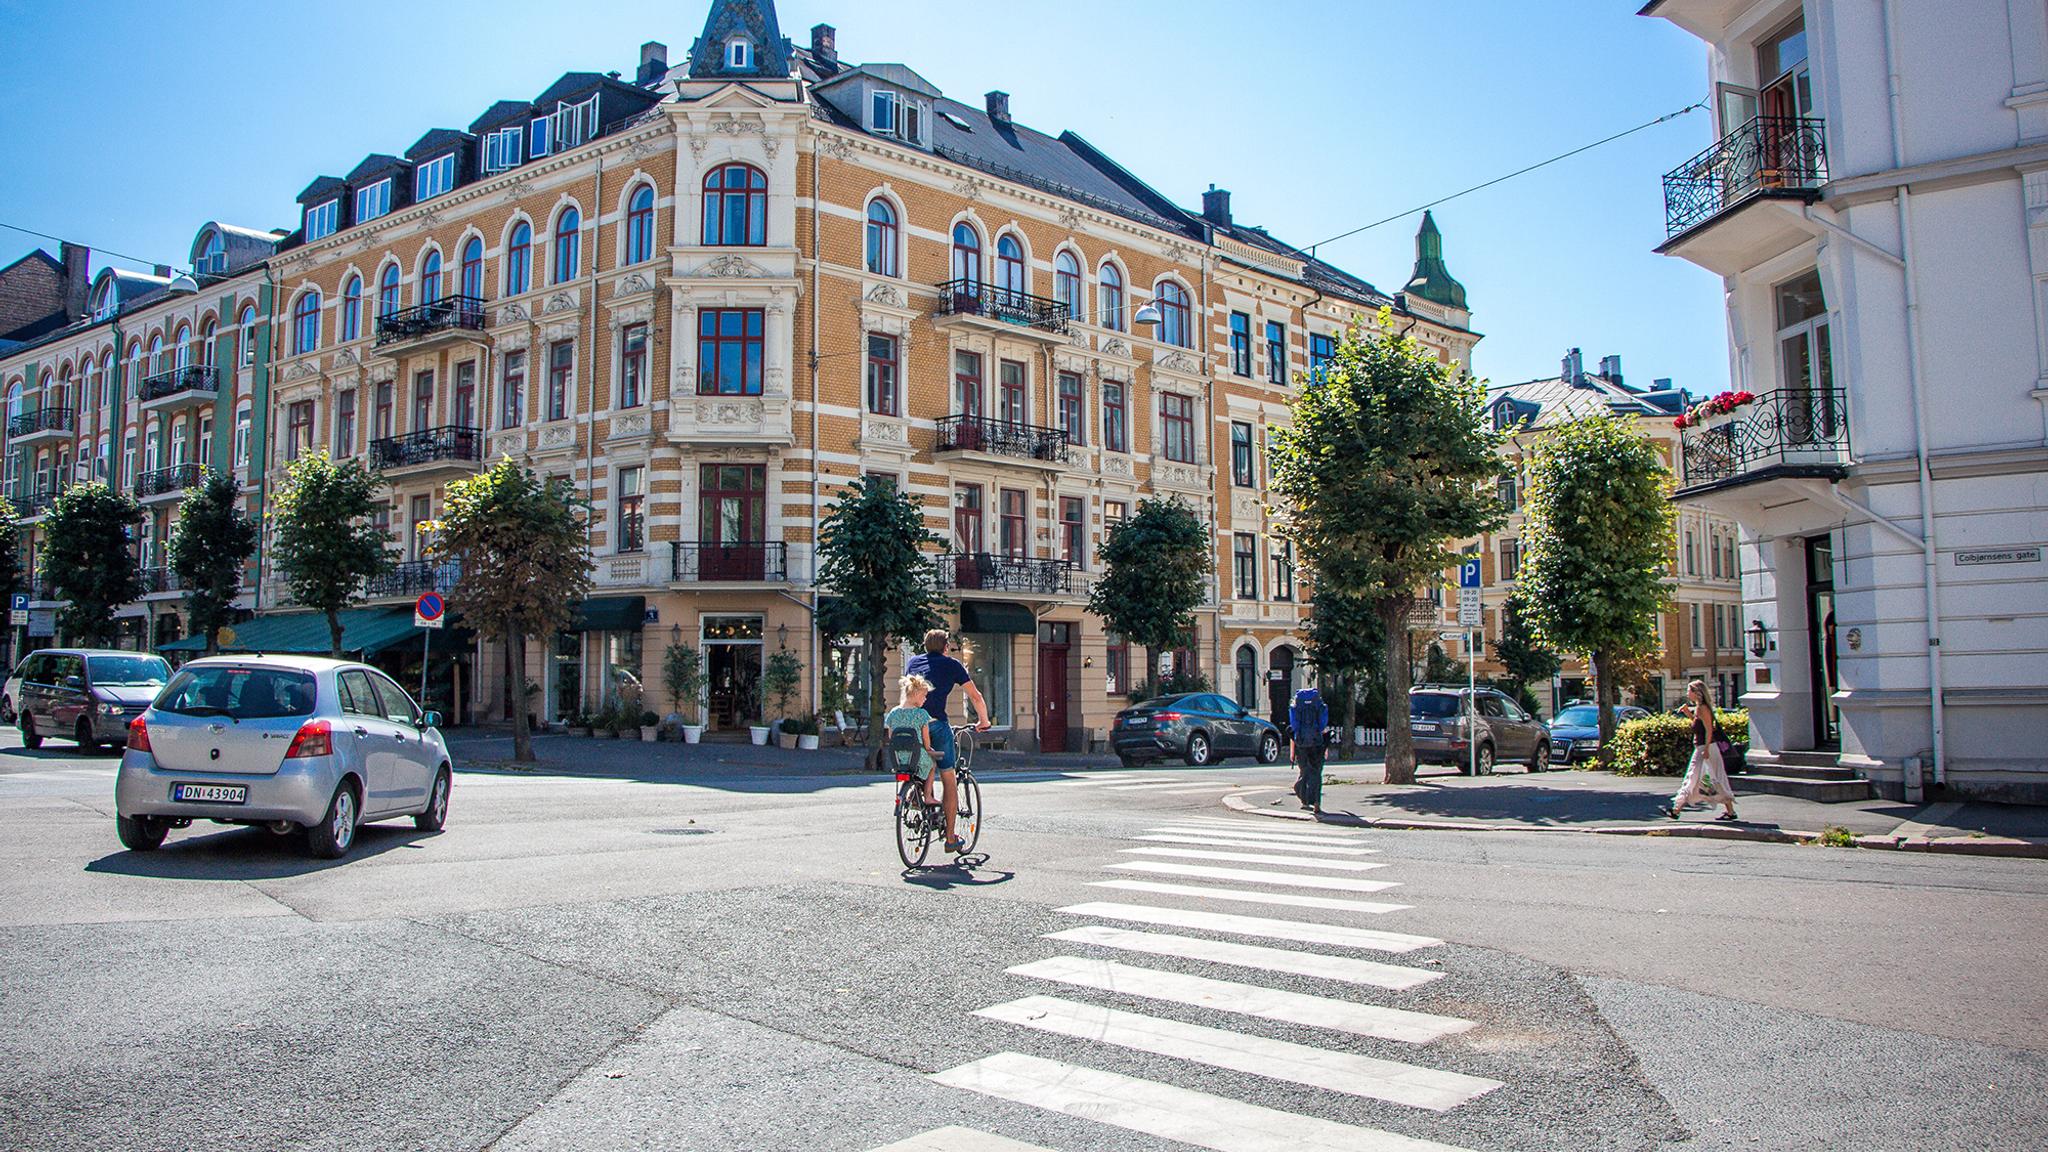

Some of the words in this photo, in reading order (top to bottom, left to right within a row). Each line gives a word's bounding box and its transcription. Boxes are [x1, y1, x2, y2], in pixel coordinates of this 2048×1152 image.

[2016, 552, 2036, 560] gate
[1465, 563, 1475, 584] P
[16, 596, 25, 608] P
[185, 787, 202, 798] DN
[207, 788, 243, 800] 43904
